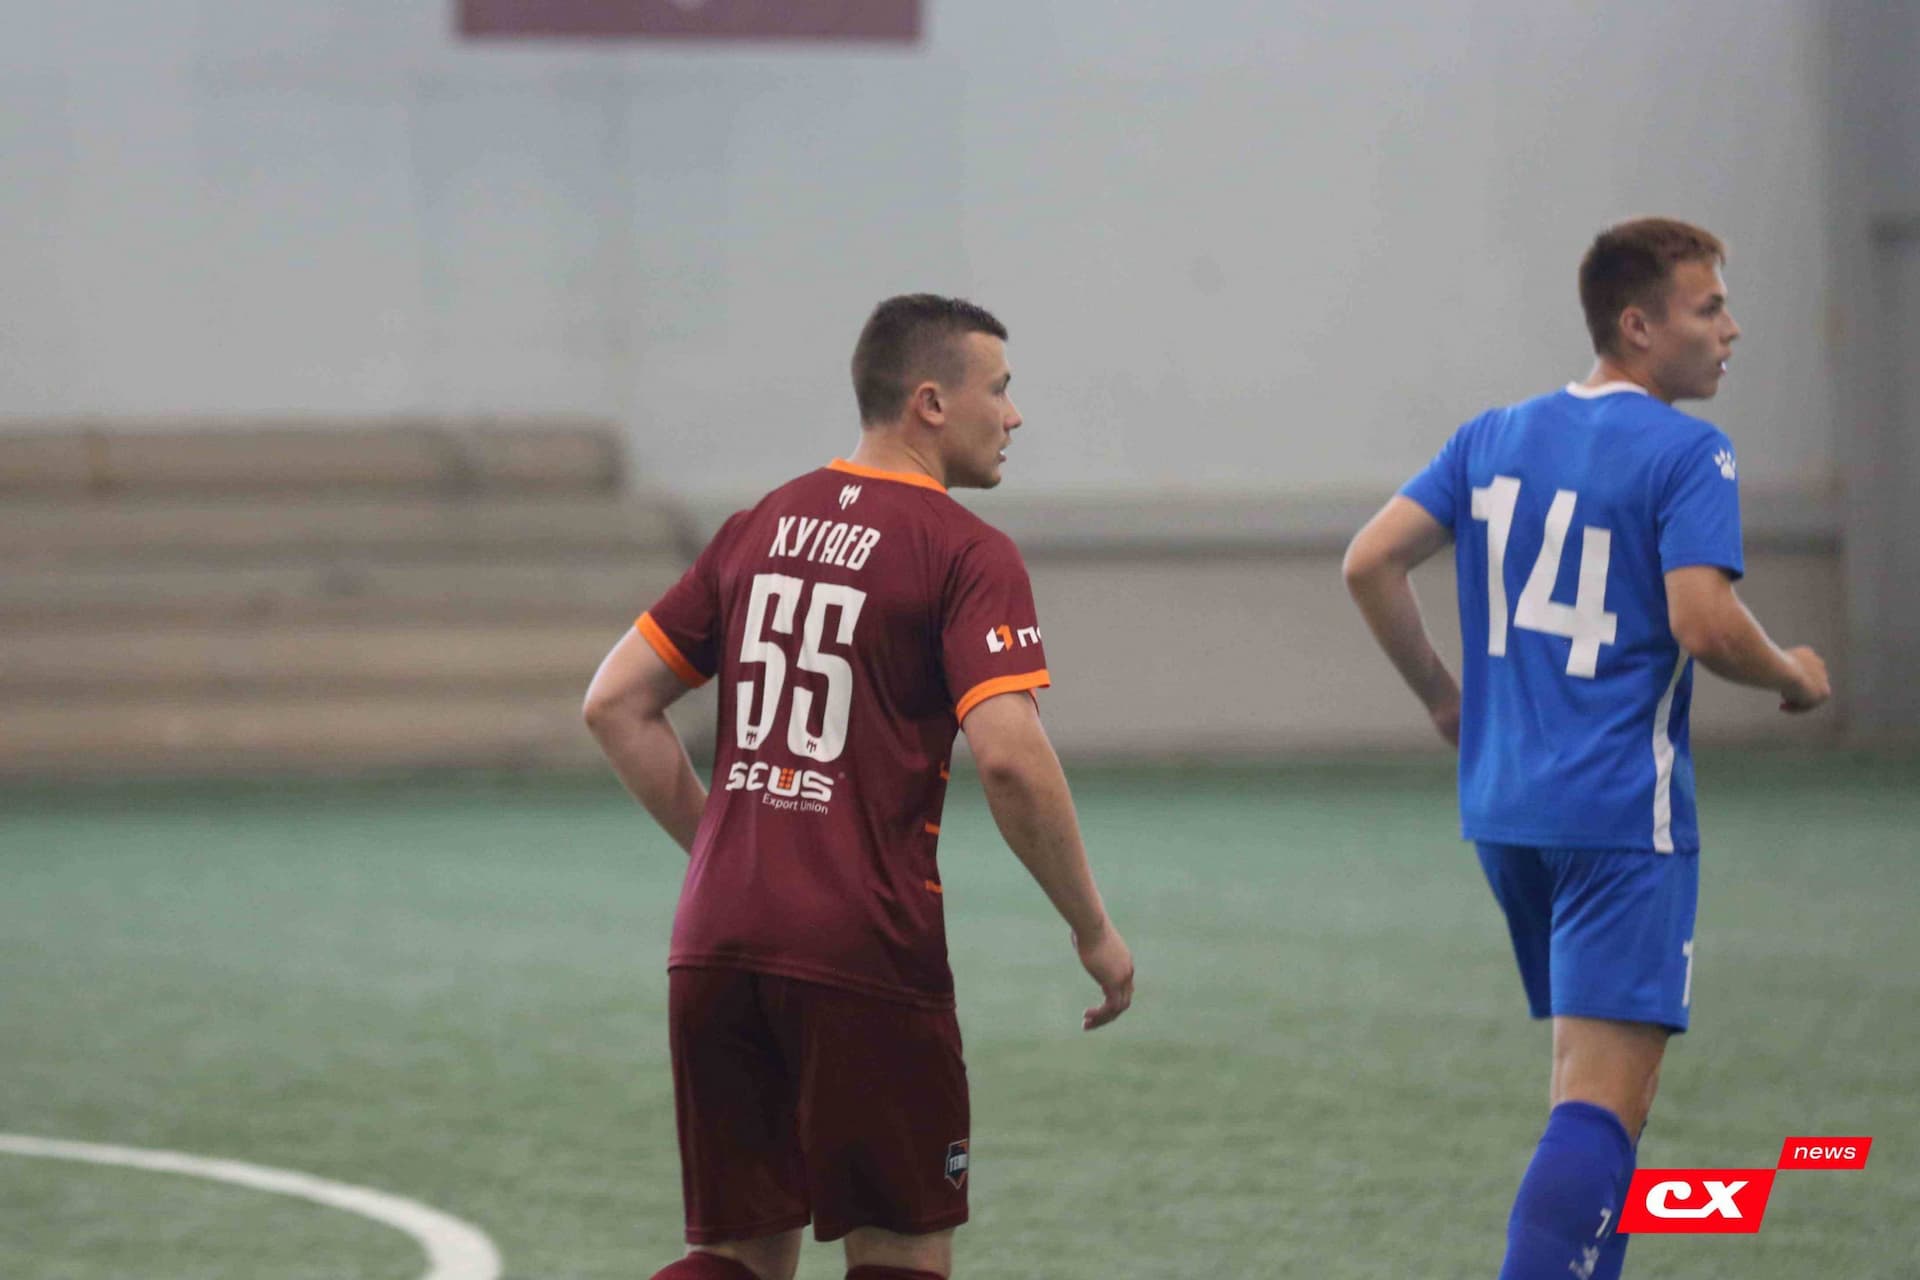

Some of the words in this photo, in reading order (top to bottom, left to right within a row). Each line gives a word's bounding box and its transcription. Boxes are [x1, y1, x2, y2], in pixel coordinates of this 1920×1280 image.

[768, 516, 881, 571] ХУГАЕВ
[1471, 475, 1618, 679] 14
[736, 573, 867, 763] 55
[725, 761, 834, 802] SEUS
[762, 793, 798, 811] Export
[800, 800, 829, 815] Union
